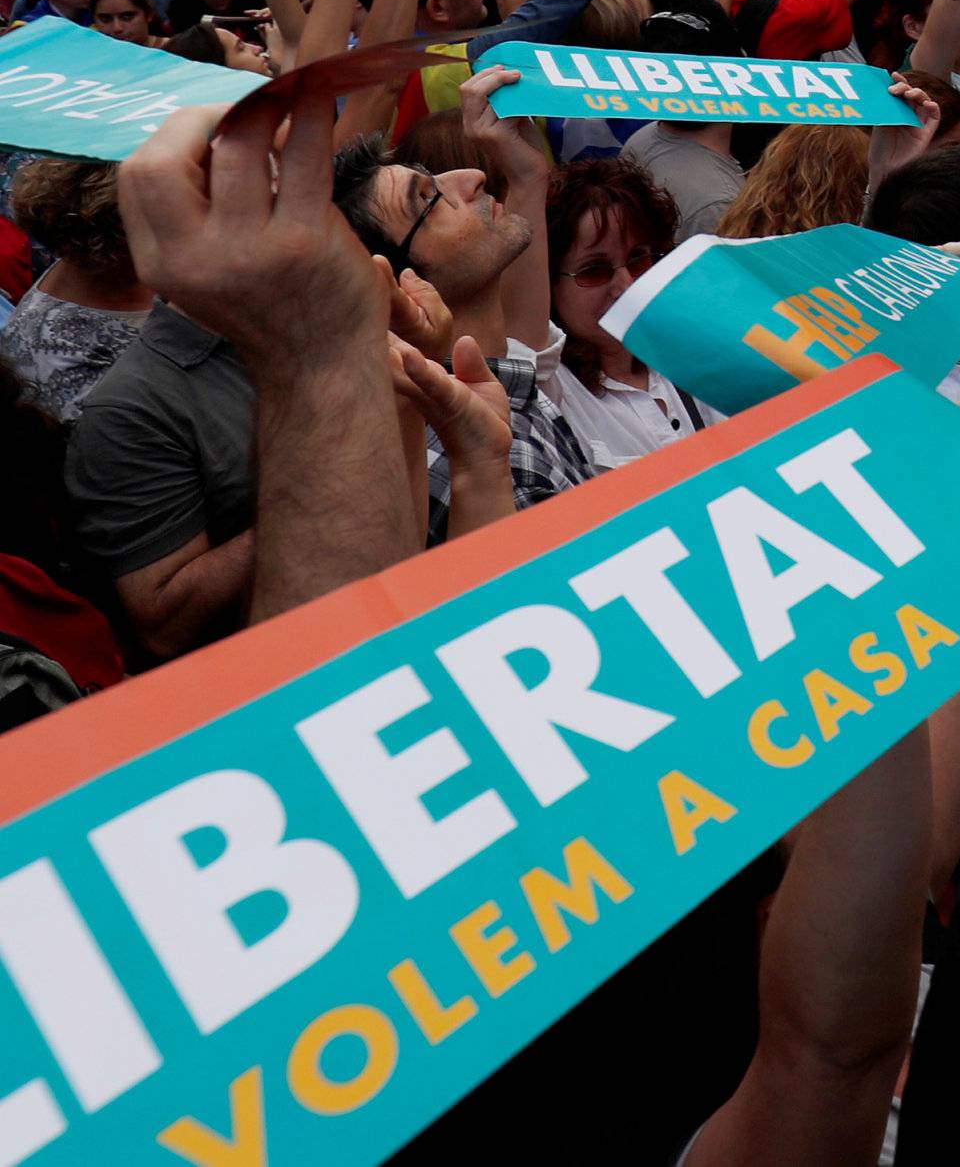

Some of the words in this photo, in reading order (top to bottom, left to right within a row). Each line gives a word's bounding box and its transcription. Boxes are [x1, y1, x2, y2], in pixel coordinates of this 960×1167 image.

[534, 50, 860, 100] LLIBERTAT
[583, 94, 628, 111] US
[638, 97, 748, 116] VOLEM
[758, 101, 781, 115] A
[787, 103, 863, 119] CASA
[742, 286, 881, 384] HELP
[656, 768, 738, 856] A
